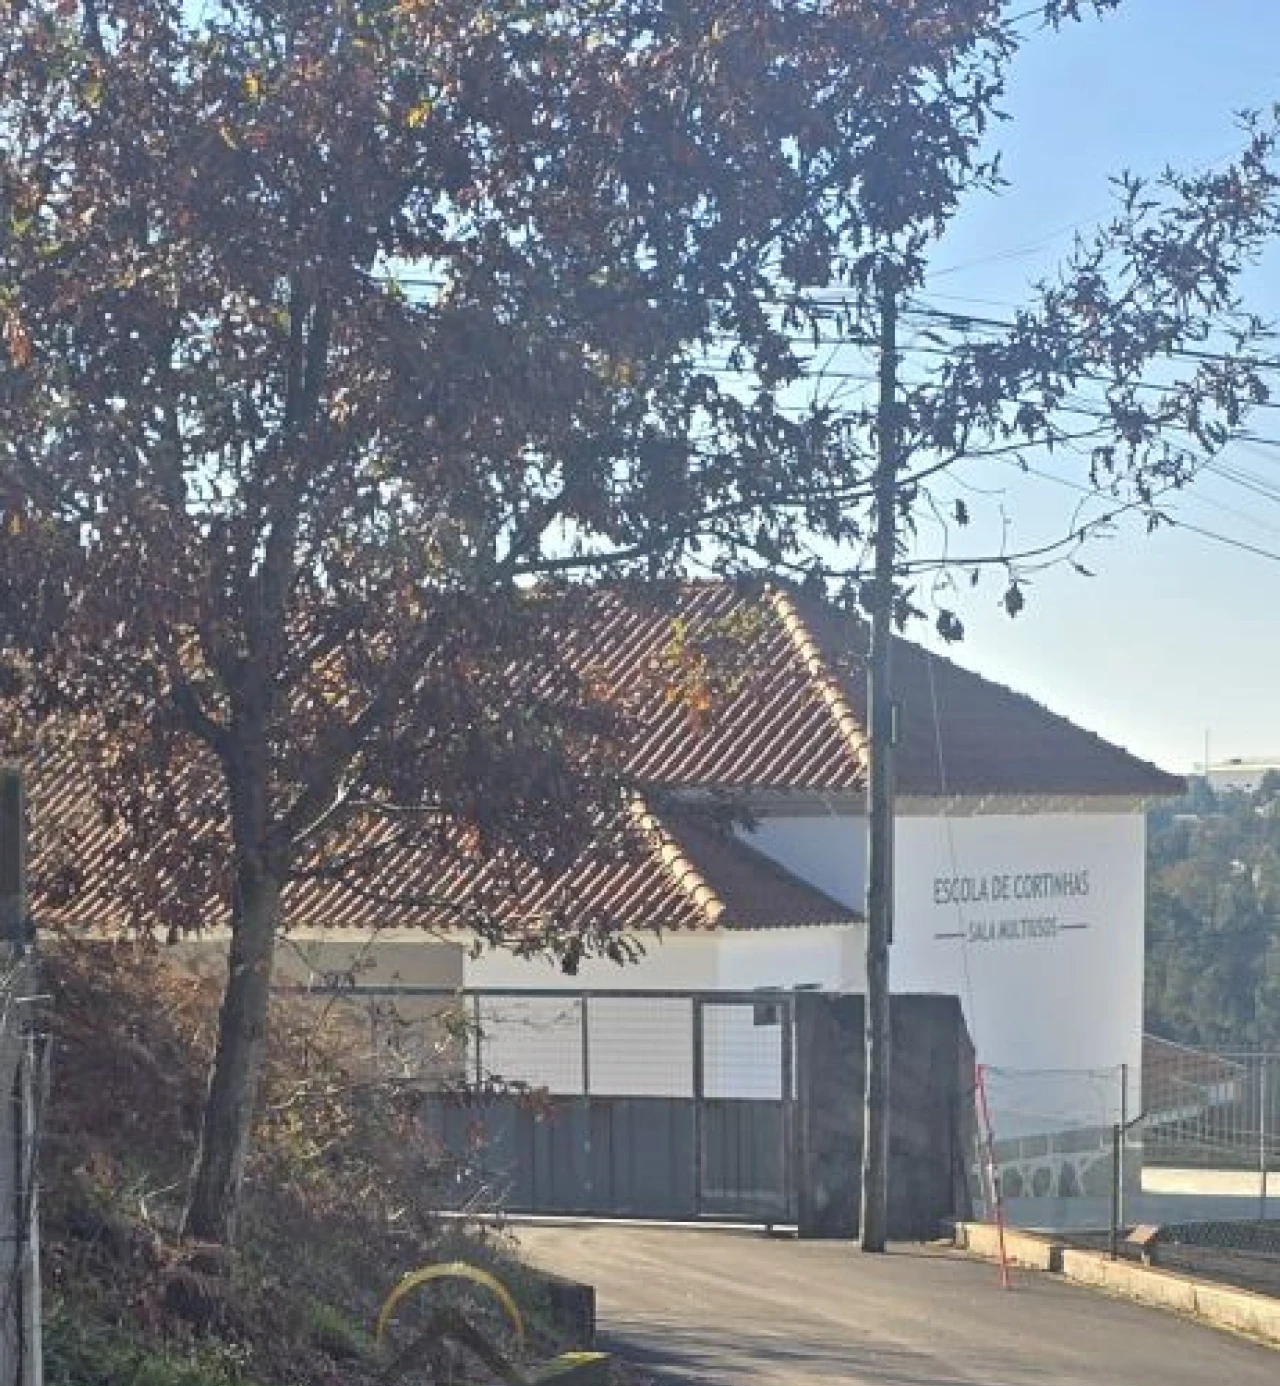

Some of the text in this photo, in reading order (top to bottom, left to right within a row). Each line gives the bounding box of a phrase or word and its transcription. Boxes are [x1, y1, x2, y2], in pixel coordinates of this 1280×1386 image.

[934, 870, 1089, 903] ESCOLA DE CORTINHAS
